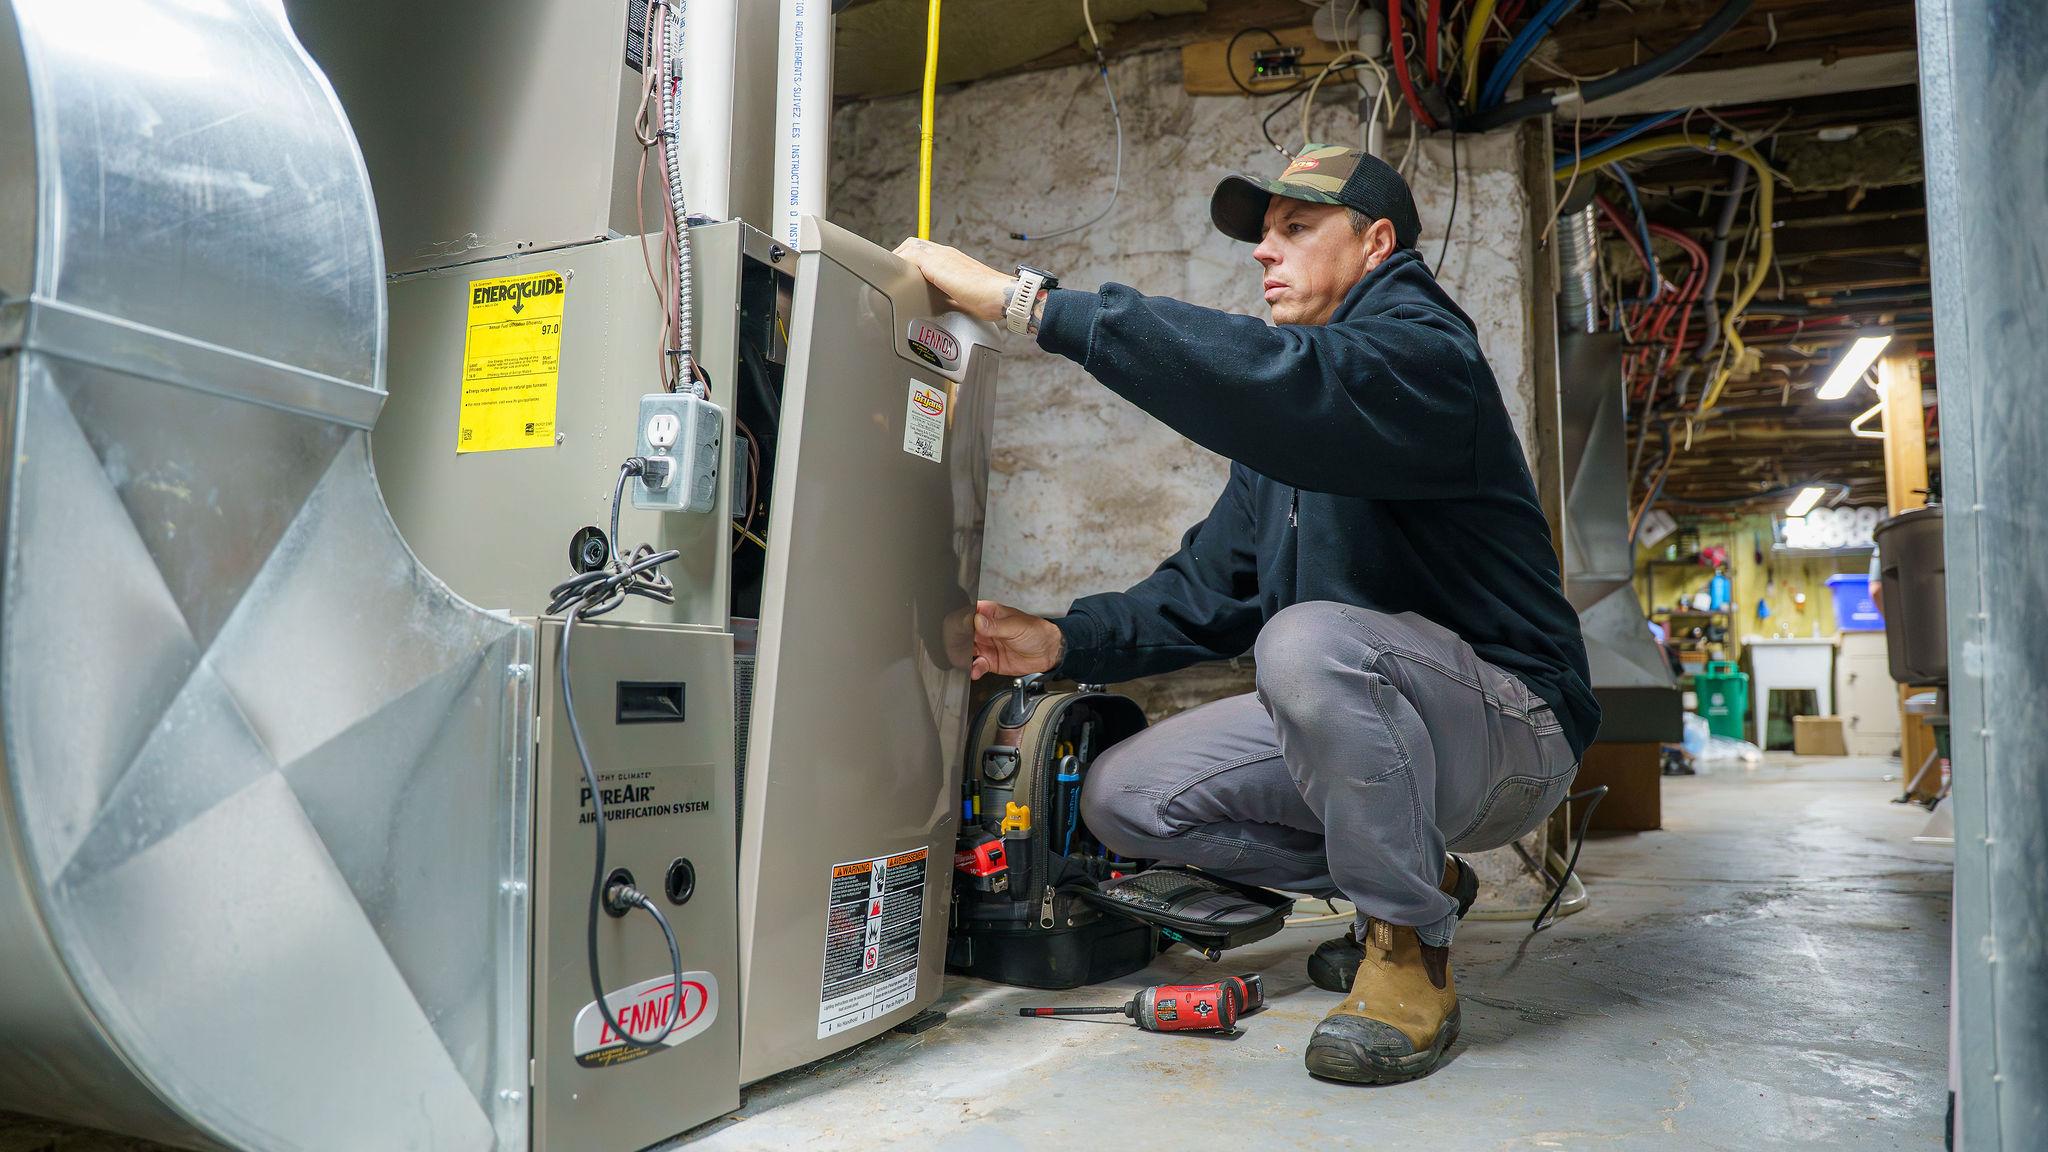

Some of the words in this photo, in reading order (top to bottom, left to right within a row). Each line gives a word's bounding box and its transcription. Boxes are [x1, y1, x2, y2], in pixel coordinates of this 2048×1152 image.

[791, 122, 801, 138] LES
[790, 144, 800, 206] INSTRUCTIONS
[473, 276, 564, 305] ENERGYGUIDE
[541, 323, 559, 336] 97.0
[918, 326, 954, 356] LENNOX
[580, 774, 615, 783] HLTHY
[579, 812, 598, 824] AIR
[602, 804, 671, 822] PURIFICATION
[672, 800, 710, 814] SYSTEM
[842, 863, 870, 876] WARNING
